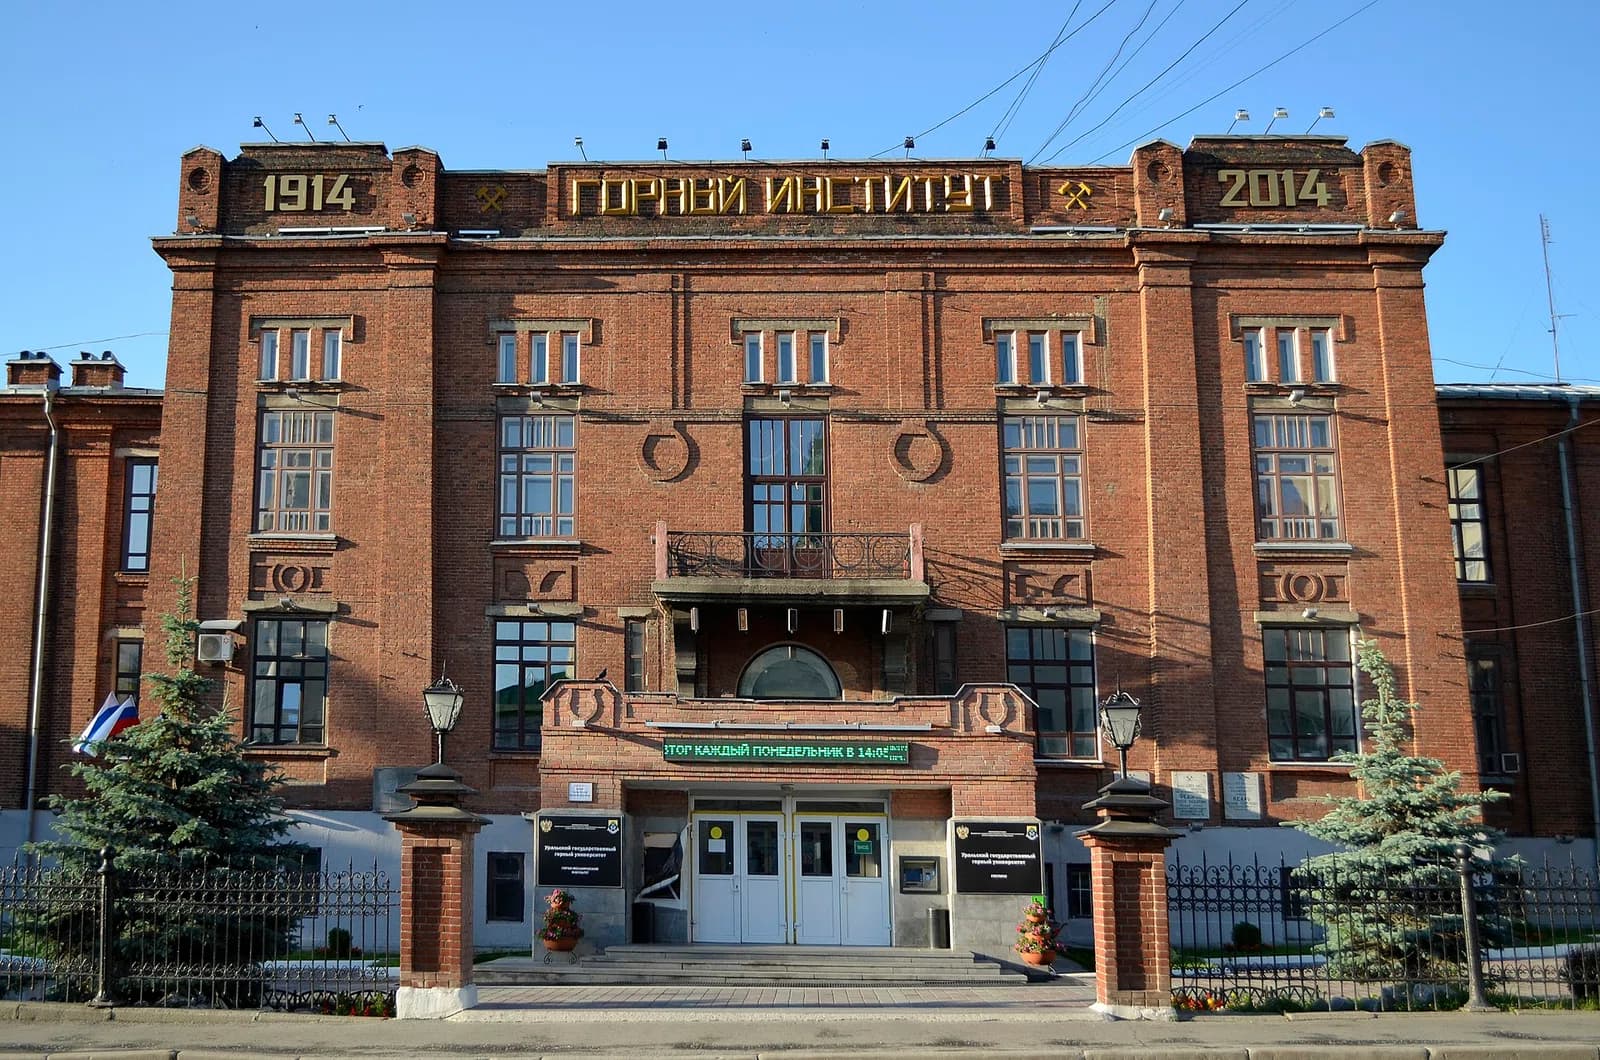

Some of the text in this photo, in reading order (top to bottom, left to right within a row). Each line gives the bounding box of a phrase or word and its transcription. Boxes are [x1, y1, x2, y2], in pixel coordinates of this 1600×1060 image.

[263, 174, 356, 211] 1914
[572, 174, 1004, 216] ГОРНЫЙ ИНСТИТУТ
[1217, 168, 1332, 208] 2014
[694, 743, 750, 757] КАЖДЫЙ
[752, 745, 844, 759] ПОНЕДЕЛЬНИК
[846, 746, 855, 758] В
